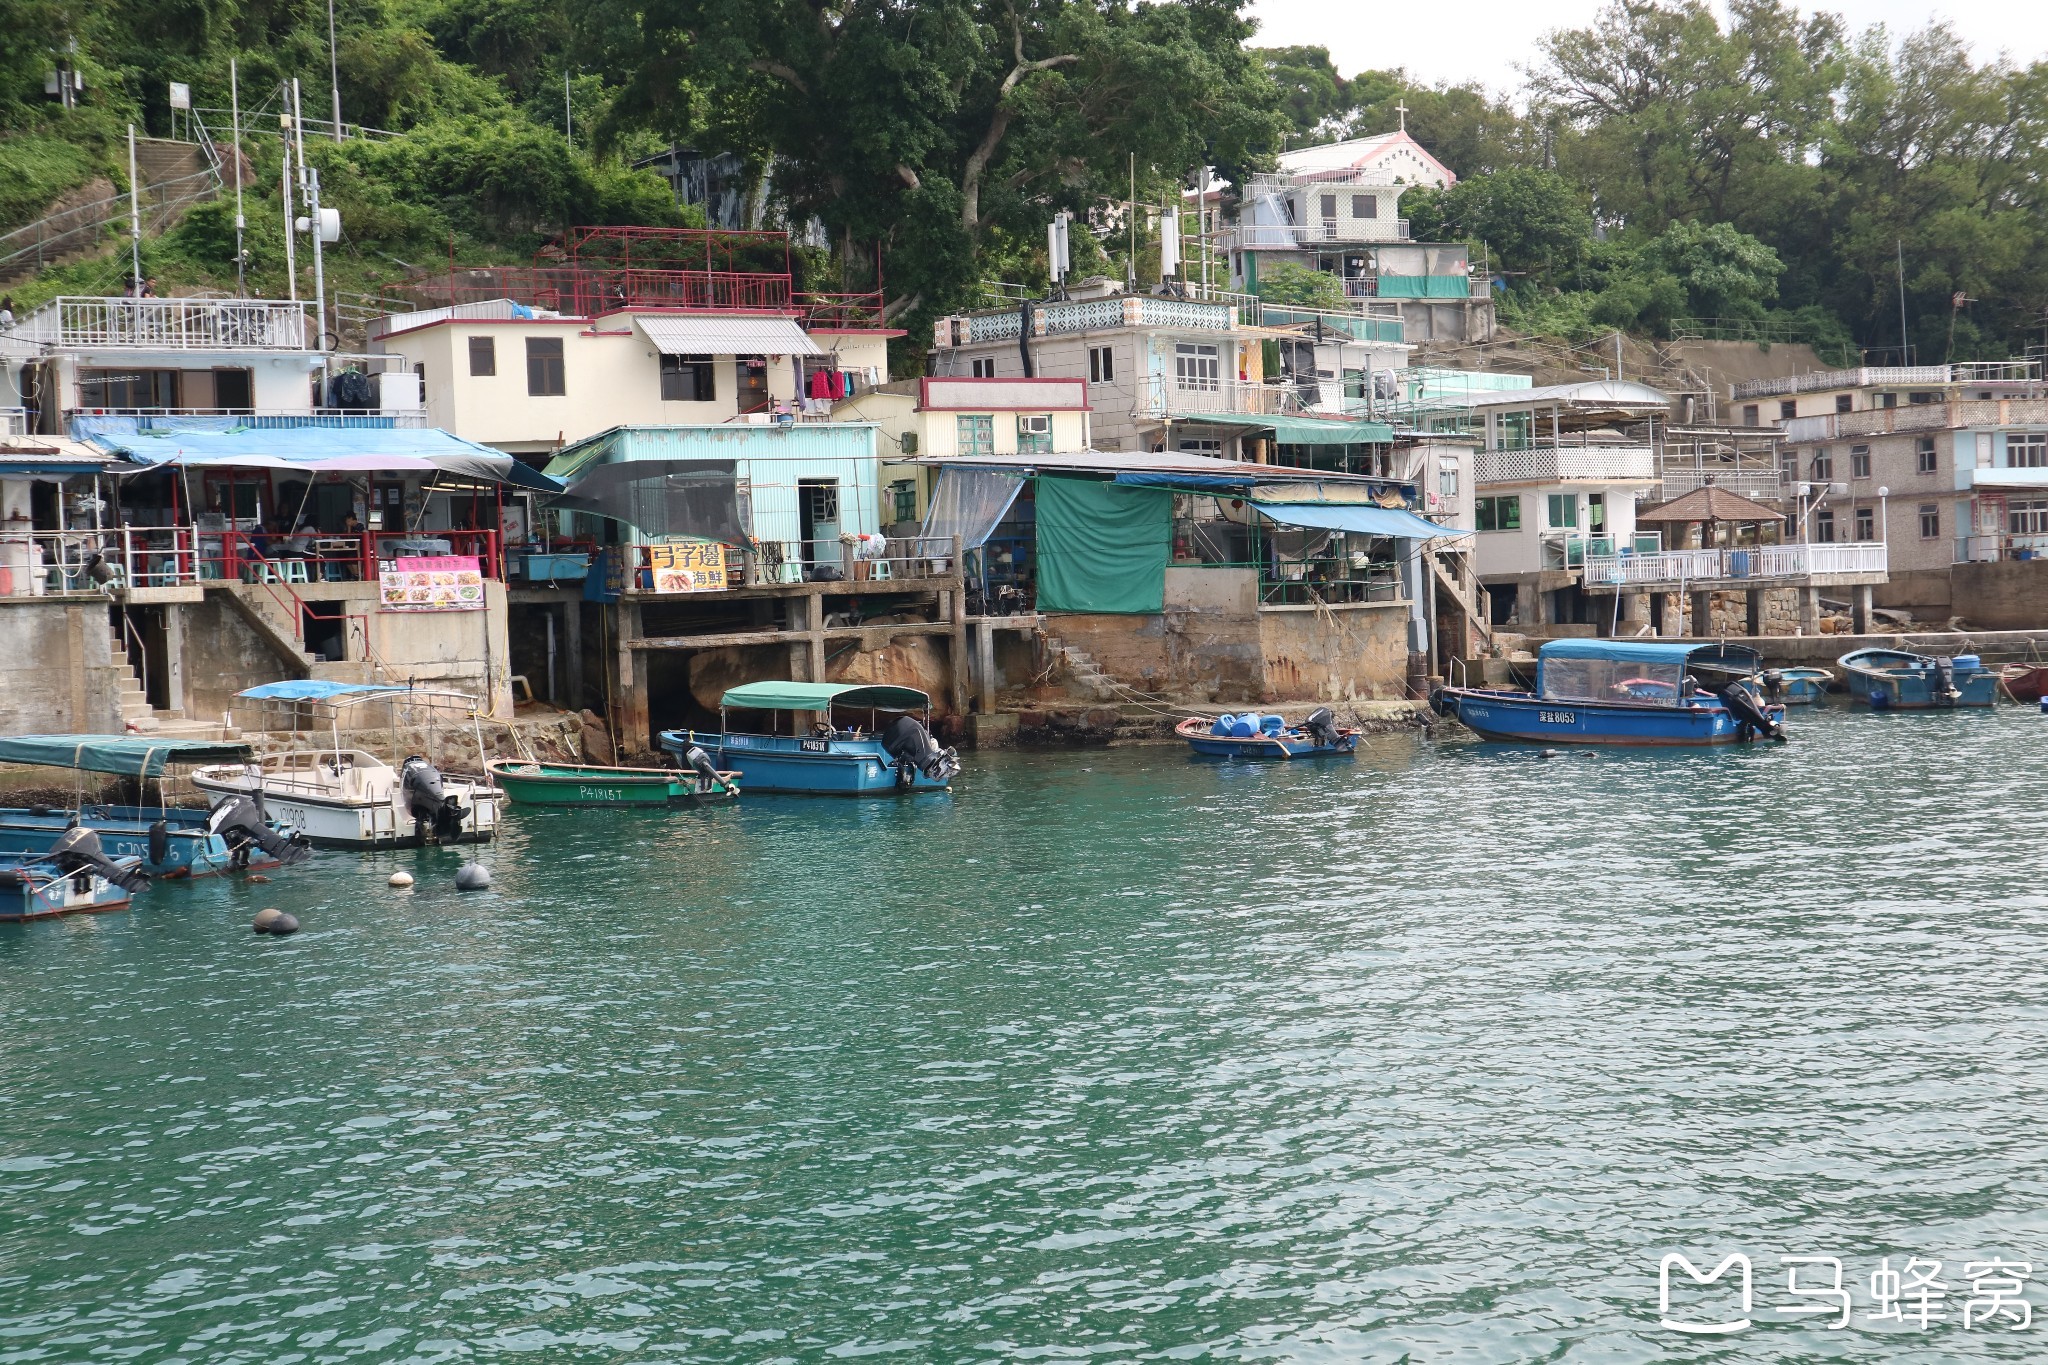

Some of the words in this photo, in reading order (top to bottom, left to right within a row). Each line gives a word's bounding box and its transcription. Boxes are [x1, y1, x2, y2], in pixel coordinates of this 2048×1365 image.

[654, 544, 721, 568] 弓字邊
[693, 570, 723, 585] 海鮮
[1539, 711, 1575, 724] 深盐8053
[117, 842, 179, 861] C7056
